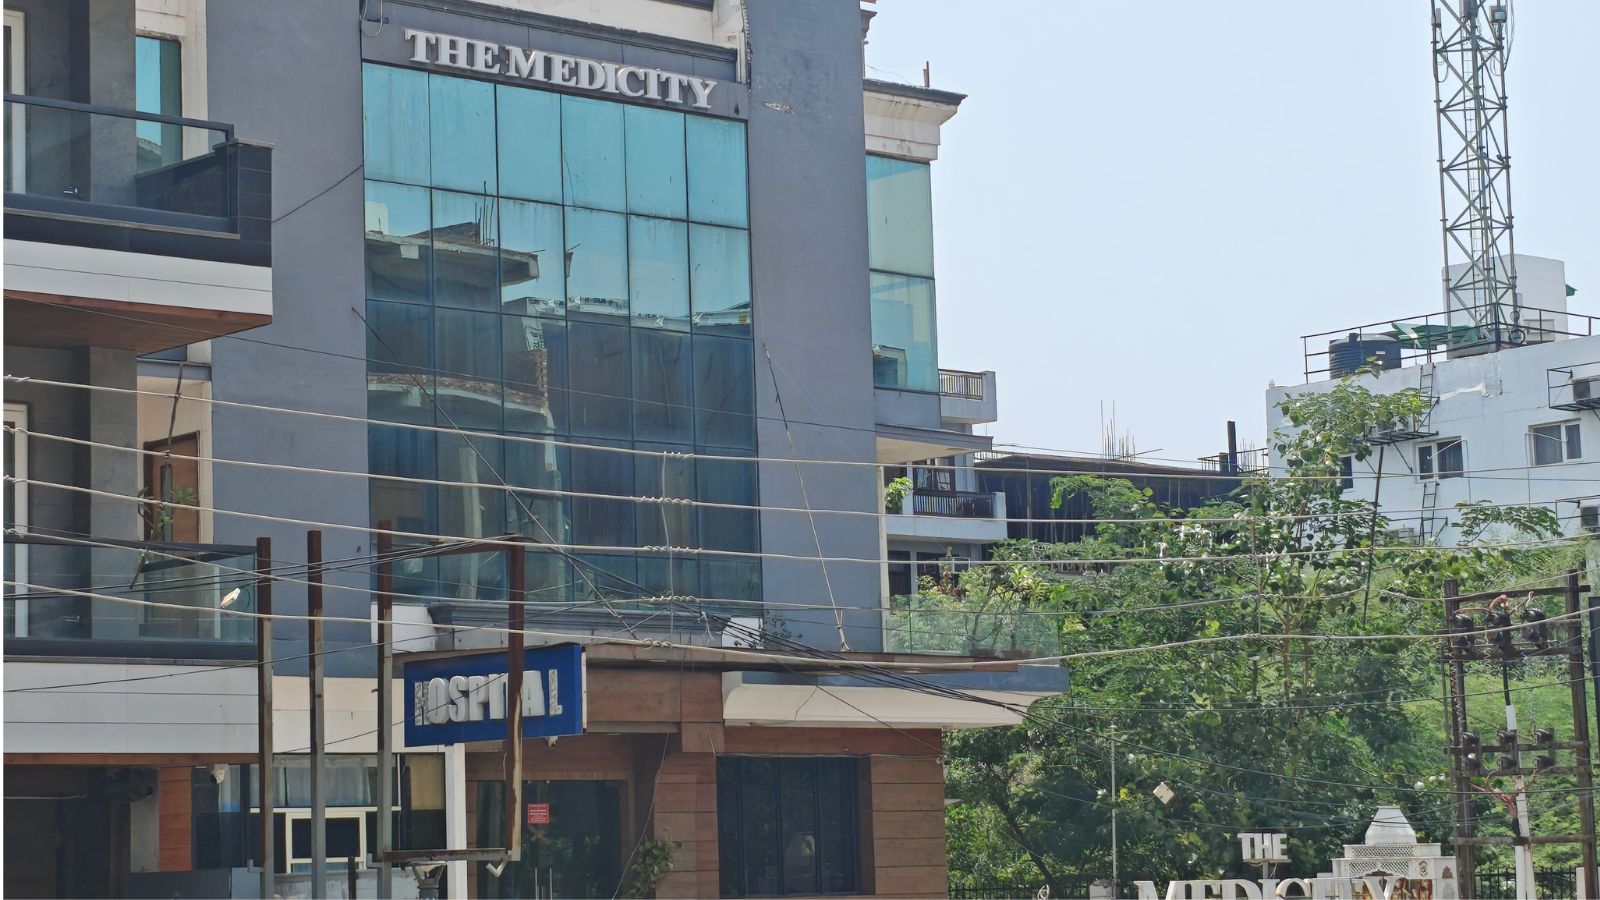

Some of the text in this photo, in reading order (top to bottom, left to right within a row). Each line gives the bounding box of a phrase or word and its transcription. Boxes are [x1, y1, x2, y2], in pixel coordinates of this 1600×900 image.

[403, 28, 718, 109] THE MEDICITY
[414, 668, 563, 727] HOSPIAL
[1236, 832, 1288, 860] THE
